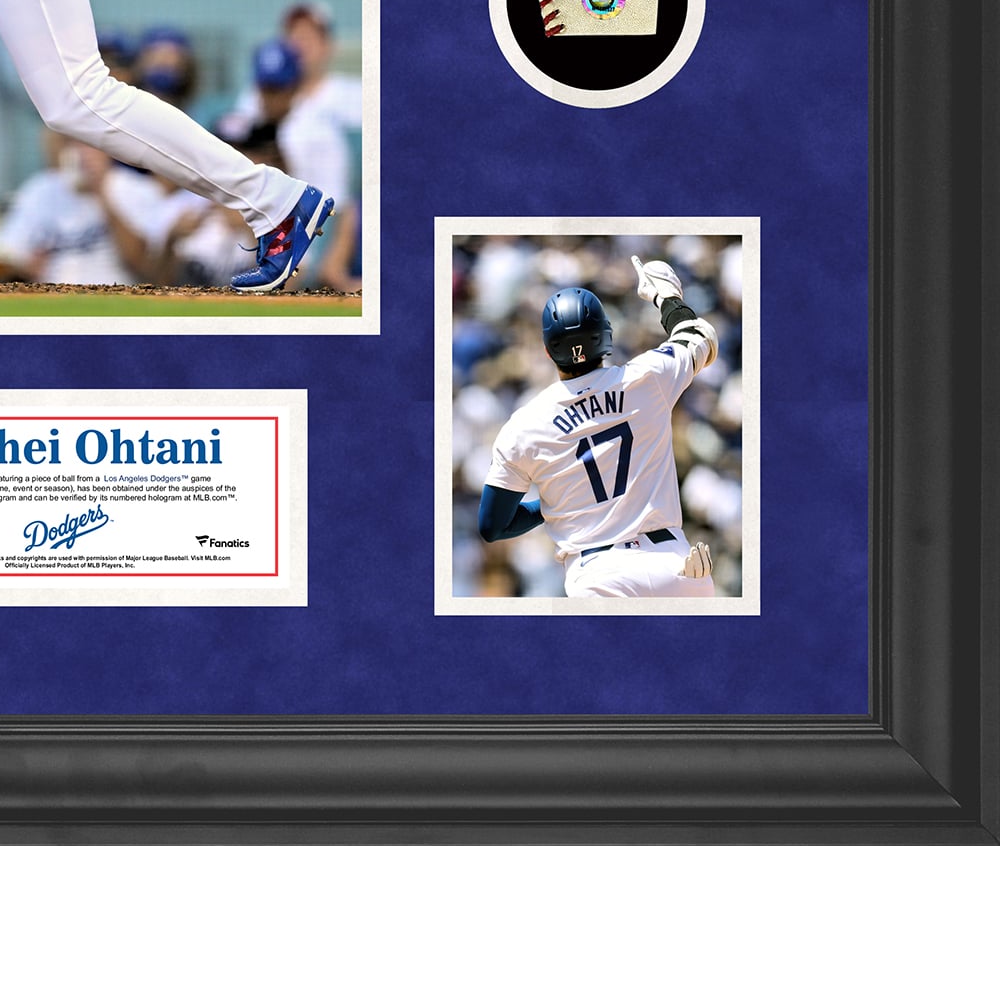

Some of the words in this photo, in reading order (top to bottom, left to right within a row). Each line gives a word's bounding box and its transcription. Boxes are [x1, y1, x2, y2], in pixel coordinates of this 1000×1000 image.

[571, 345, 583, 356] 17
[552, 391, 625, 435] OHTANI
[75, 428, 223, 465] Ohtani
[575, 421, 635, 504] 17
[32, 475, 51, 483] piece
[119, 475, 148, 483] Angeles
[151, 475, 189, 483] Dodgers™
[44, 485, 75, 493] season),
[182, 485, 214, 493] auspices
[89, 494, 97, 502] by
[148, 494, 182, 502] hologram
[23, 504, 109, 552] Dodgers
[209, 538, 250, 548] Fanatics
